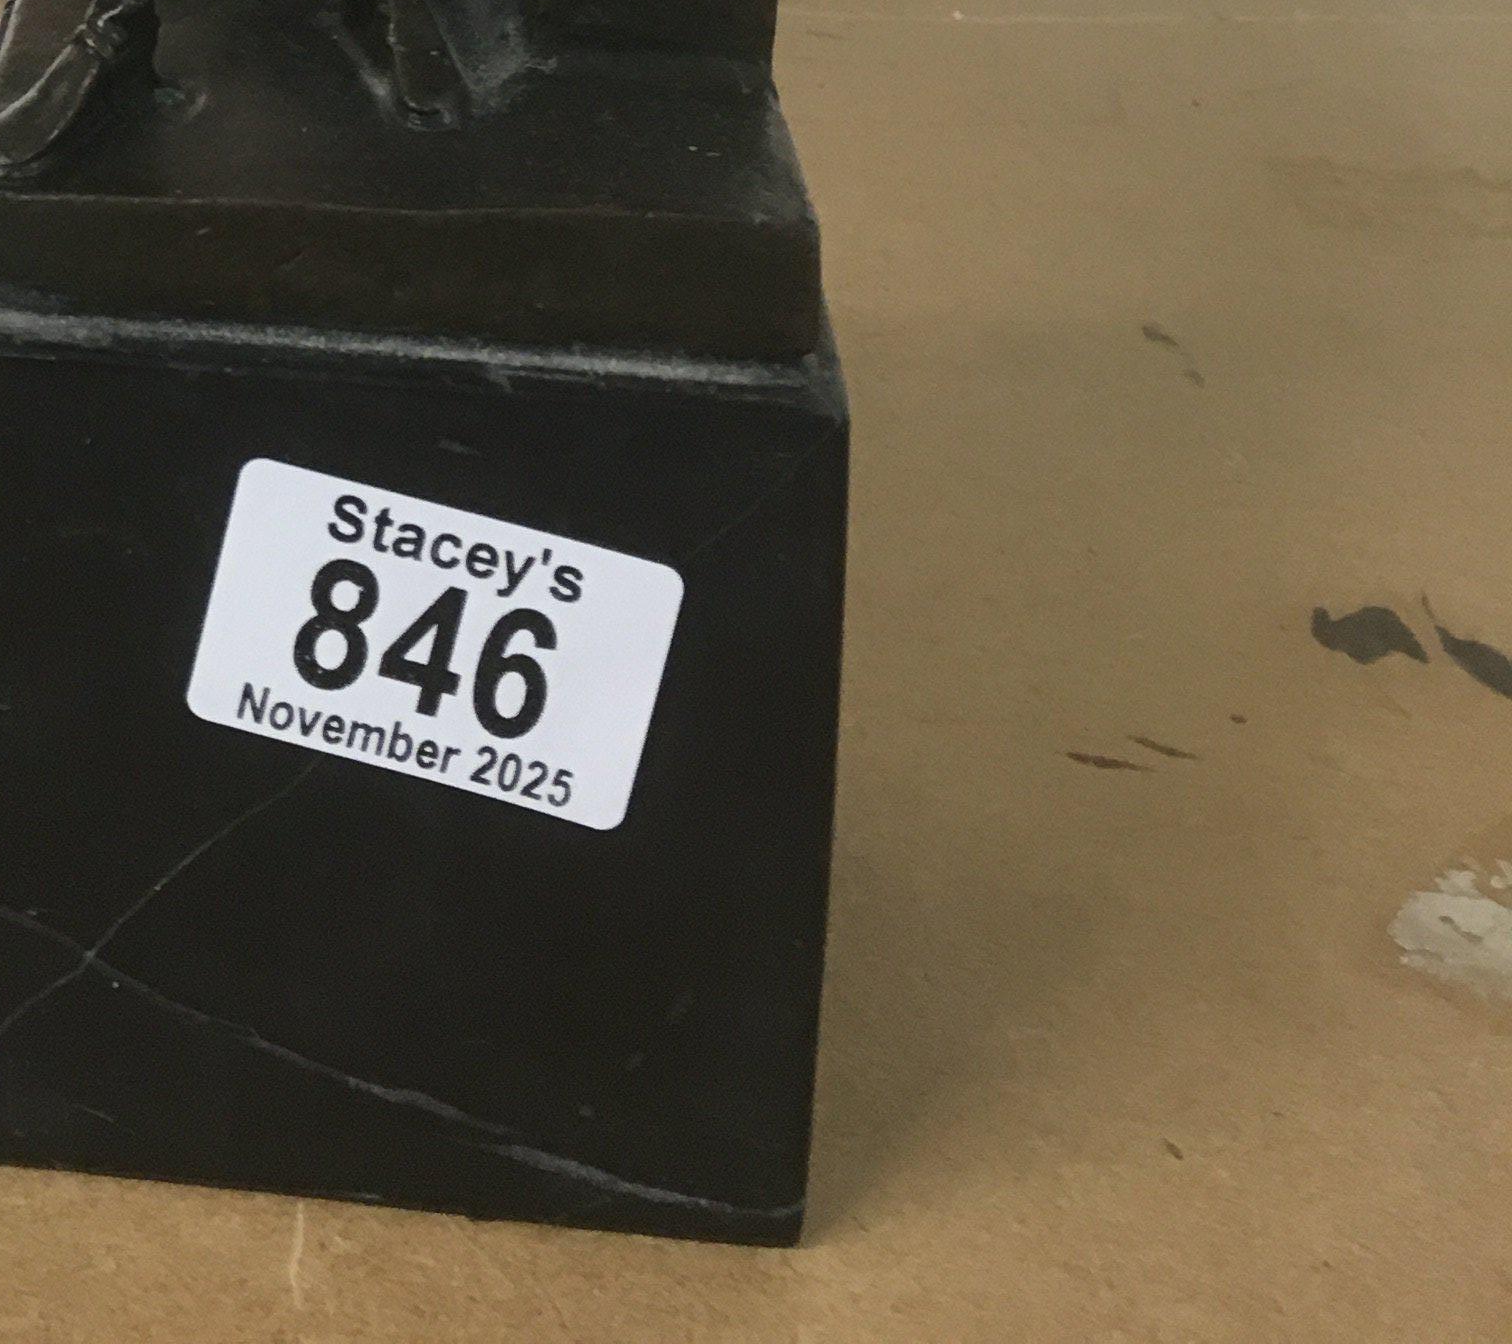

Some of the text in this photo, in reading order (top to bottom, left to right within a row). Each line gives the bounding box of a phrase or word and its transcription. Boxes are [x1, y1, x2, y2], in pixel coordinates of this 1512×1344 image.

[327, 494, 585, 604] Stacey's
[293, 558, 558, 740] 846
[236, 682, 574, 808] November 2025
